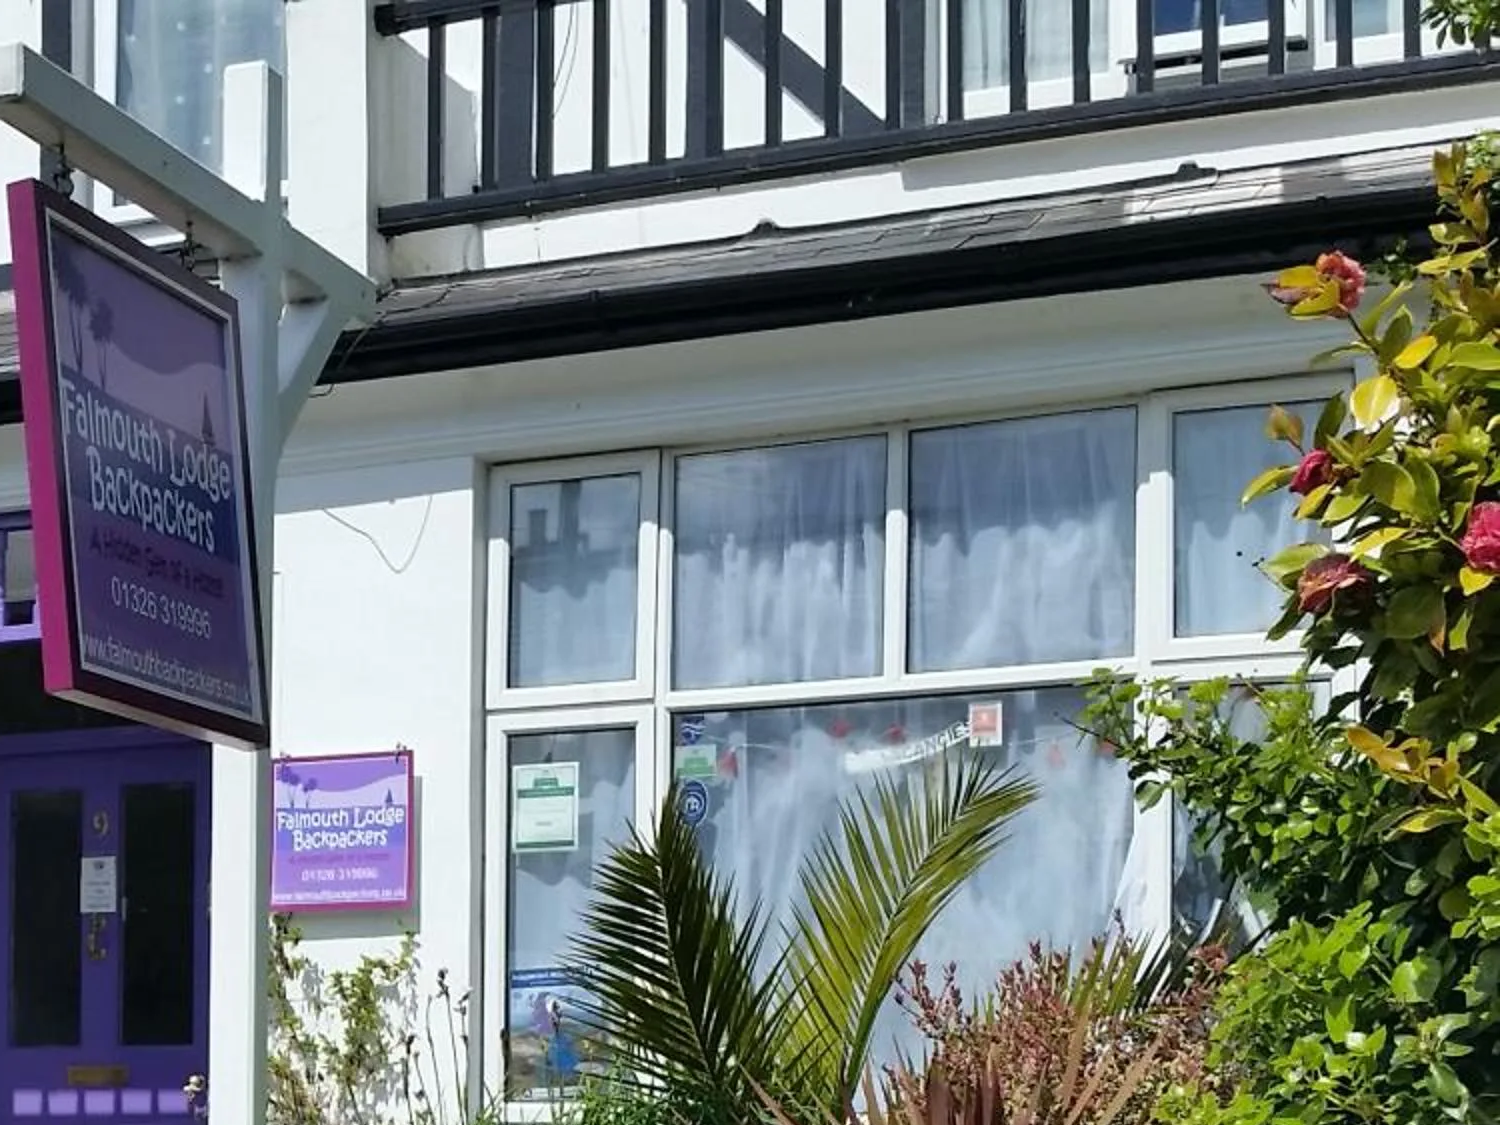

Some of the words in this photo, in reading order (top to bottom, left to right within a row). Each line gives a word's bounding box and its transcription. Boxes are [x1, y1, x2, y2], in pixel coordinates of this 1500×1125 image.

[59, 377, 163, 474] Falmouth
[167, 428, 231, 503] Lodge
[86, 445, 215, 553] Backpackers
[111, 575, 157, 621] 01326
[93, 810, 109, 835] 9
[277, 809, 349, 832] Falmouth
[353, 807, 405, 828] Lodge
[292, 829, 389, 851] Backpackers
